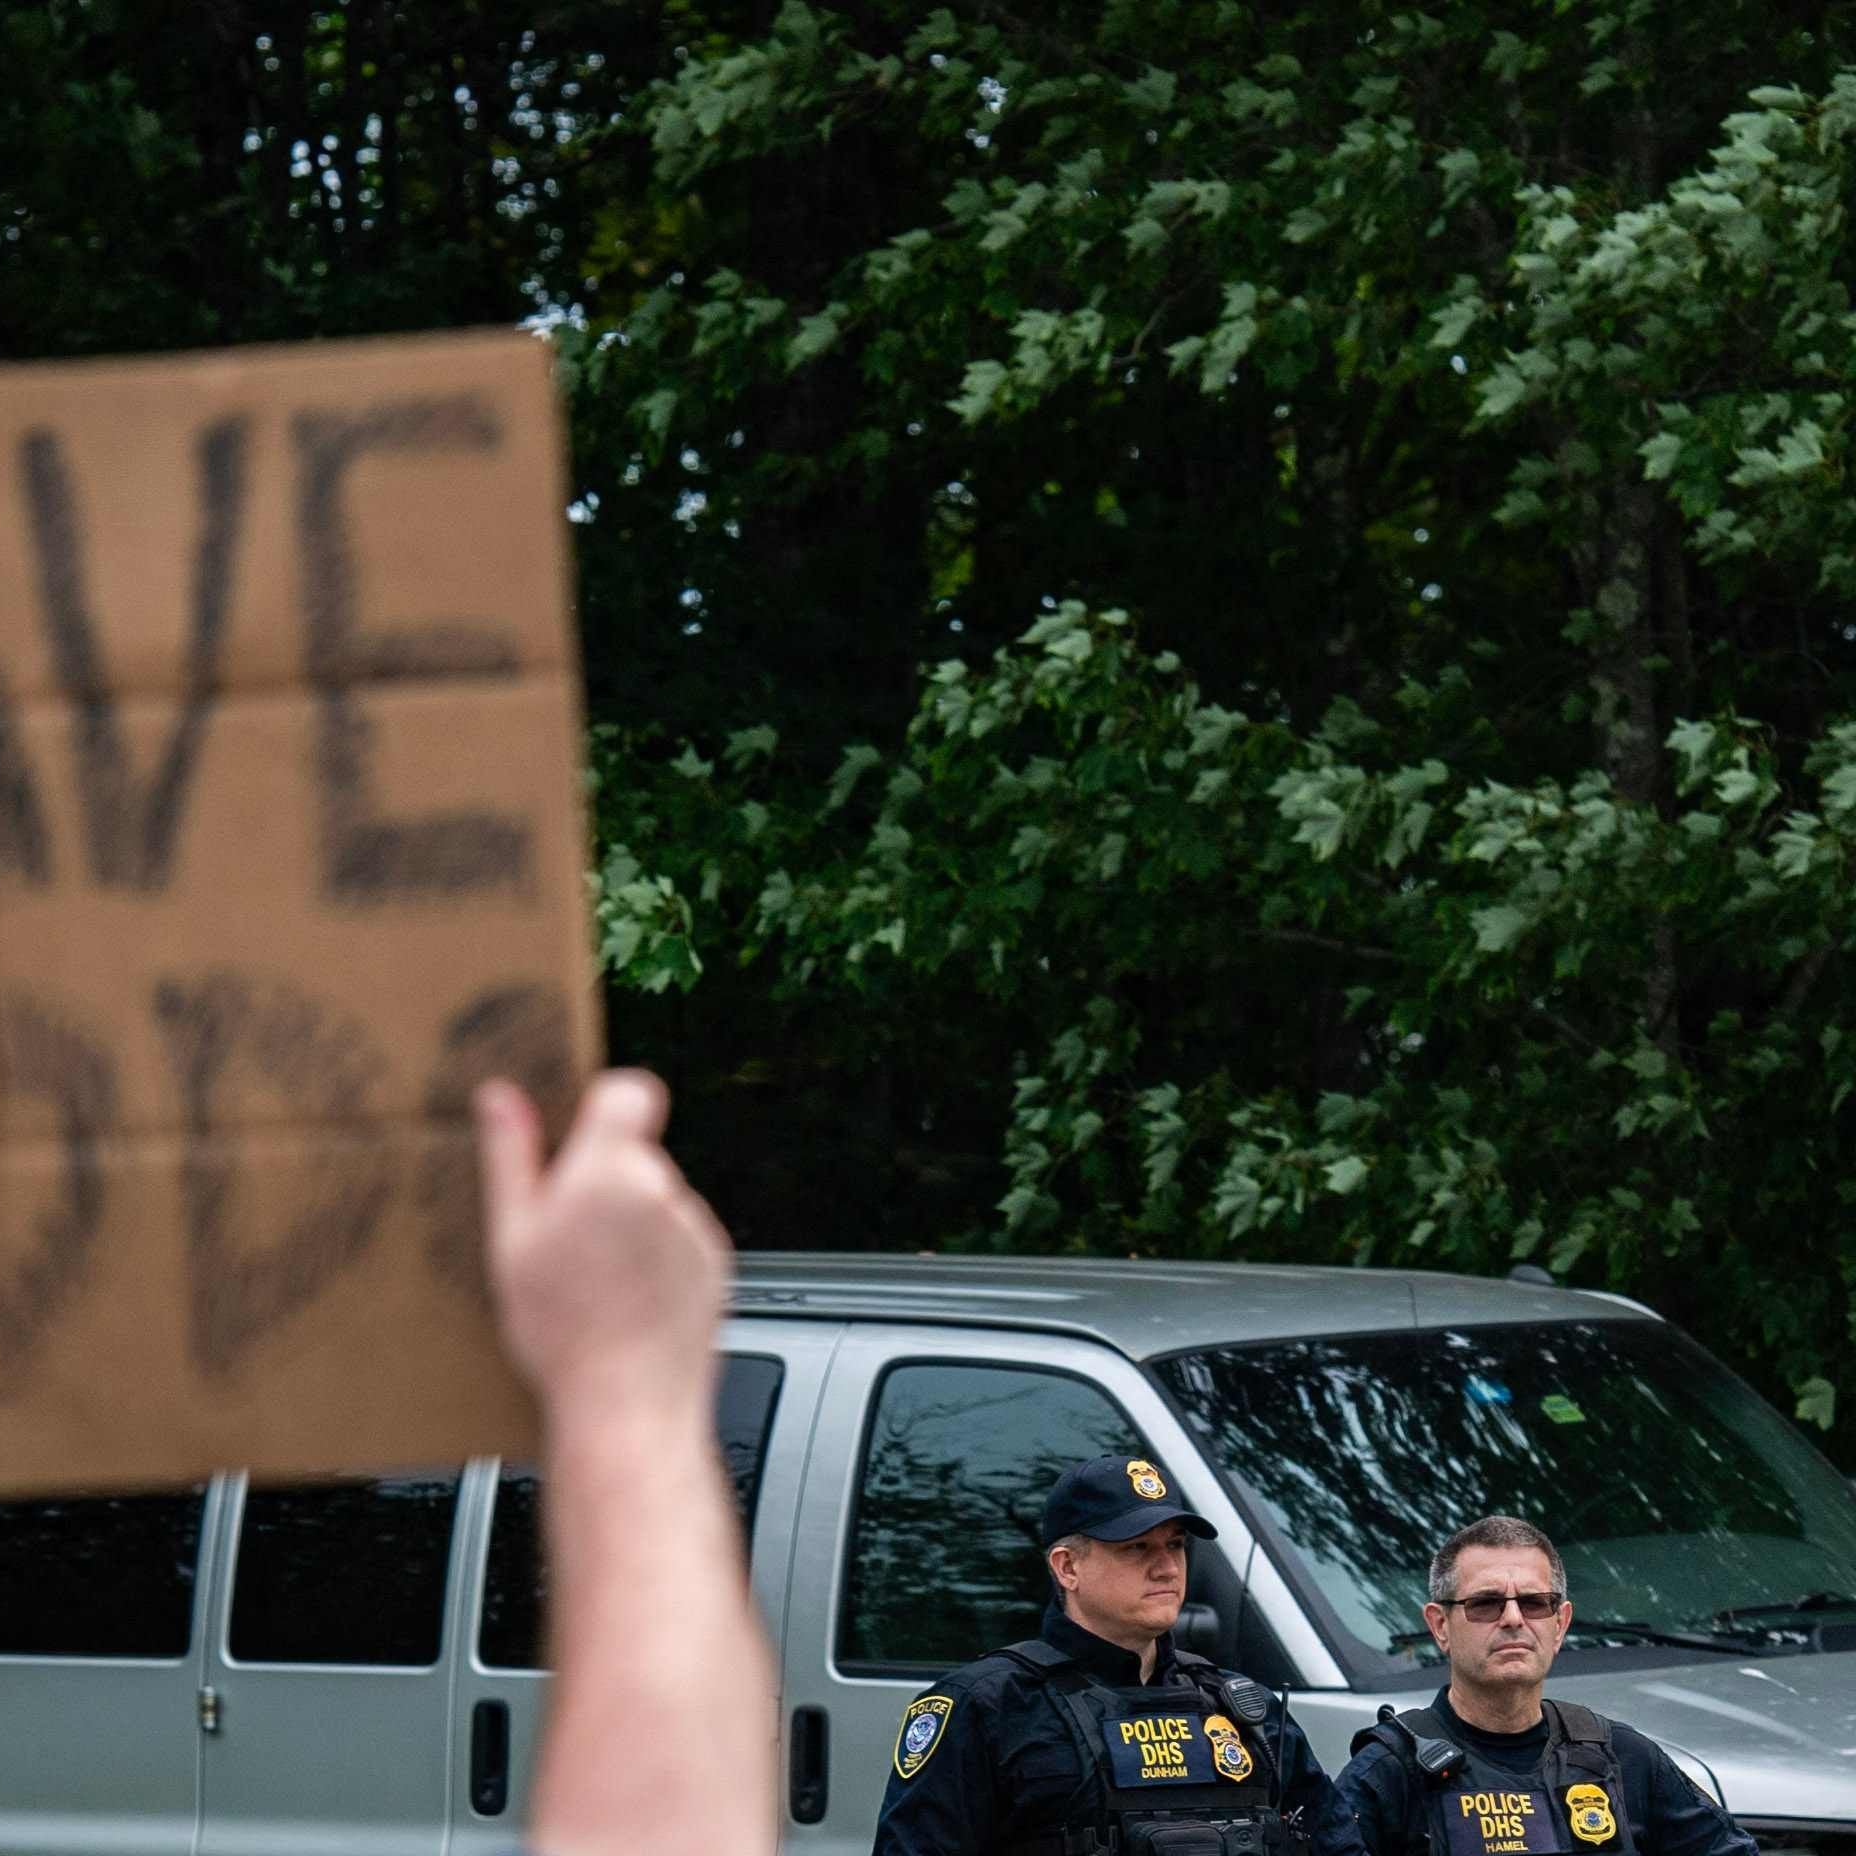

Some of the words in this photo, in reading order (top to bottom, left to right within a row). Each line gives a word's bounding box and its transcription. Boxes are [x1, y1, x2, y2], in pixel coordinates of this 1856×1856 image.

[910, 1701, 948, 1718] POLICE
[1120, 1718, 1193, 1745] POLICE
[1140, 1741, 1184, 1766] DHS
[1141, 1766, 1188, 1779] DUNHAM
[1460, 1793, 1535, 1817] POLICE
[1480, 1815, 1525, 1839] DHS
[1485, 1839, 1529, 1853] HAMEL
